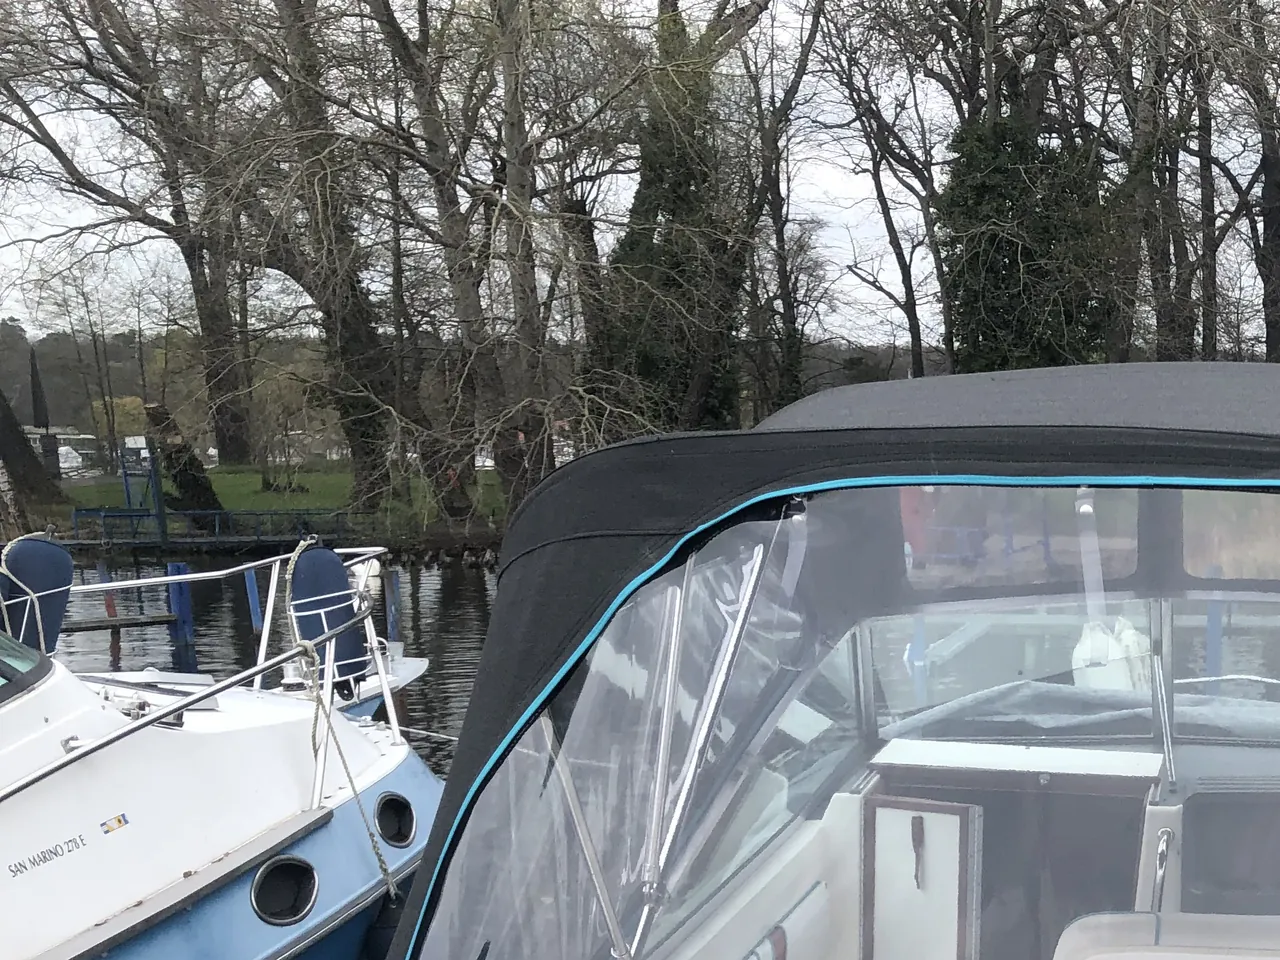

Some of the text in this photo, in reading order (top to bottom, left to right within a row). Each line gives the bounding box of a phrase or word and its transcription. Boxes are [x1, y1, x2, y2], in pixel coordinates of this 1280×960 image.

[8, 834, 87, 878] SAN MARINO 278 E
